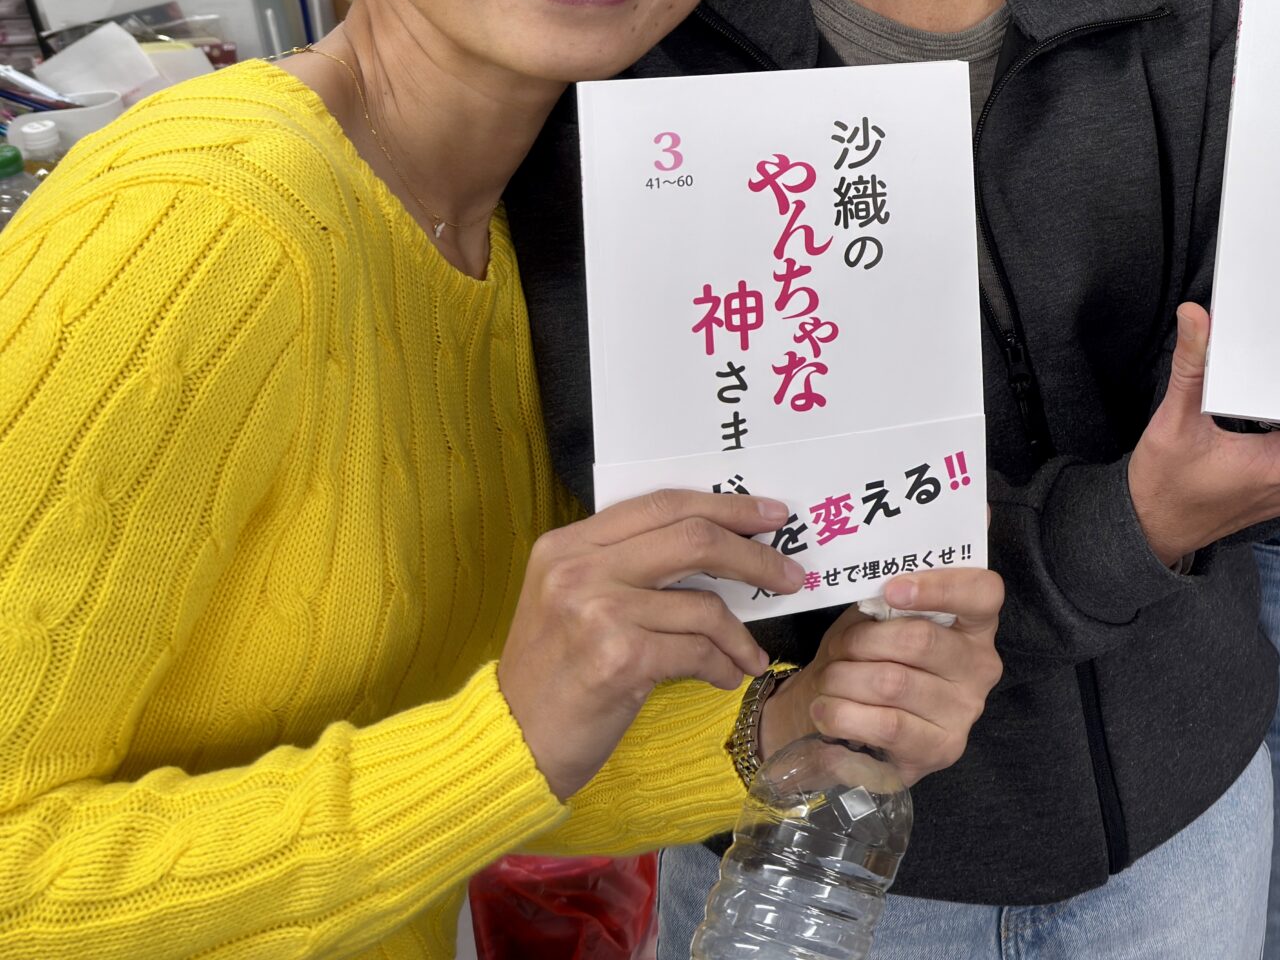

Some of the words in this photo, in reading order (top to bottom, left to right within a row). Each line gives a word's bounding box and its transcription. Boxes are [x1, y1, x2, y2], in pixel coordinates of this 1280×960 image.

[653, 131, 684, 172] 3
[830, 116, 891, 271] 沙織の
[747, 153, 840, 413] やんちゃな
[691, 279, 764, 452] 神さま
